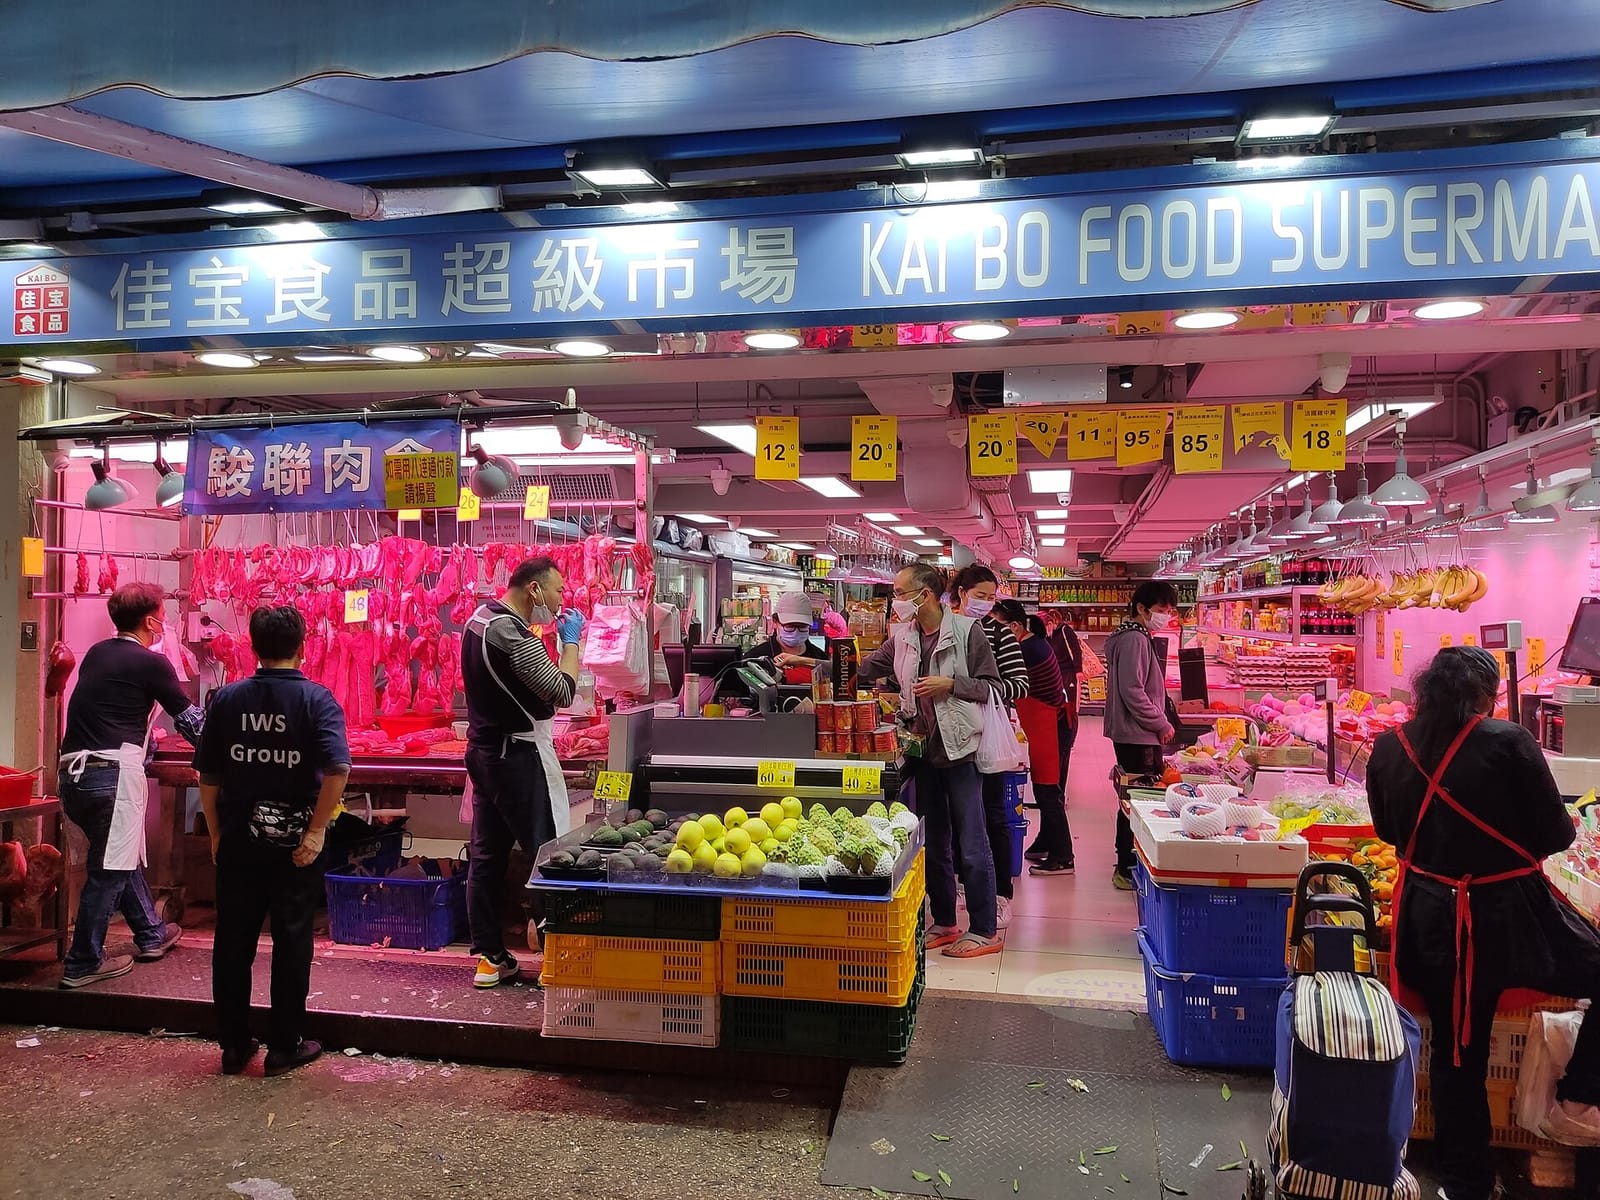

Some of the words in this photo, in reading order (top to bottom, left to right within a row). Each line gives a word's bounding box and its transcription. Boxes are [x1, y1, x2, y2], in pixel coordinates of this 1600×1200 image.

[862, 216, 946, 297] KAI
[974, 208, 1050, 291] BO
[1079, 196, 1243, 286] FOOD
[1271, 173, 1600, 274] SUPERMA
[28, 275, 42, 283] KAI
[110, 224, 799, 331] 佳宝食品超級市場
[20, 289, 64, 309] 佳宝
[19, 313, 63, 333] 食品
[1077, 428, 1100, 442] 11
[1124, 430, 1150, 448] 95
[1181, 434, 1208, 453] 85
[1302, 430, 1330, 449] 18
[763, 443, 786, 461] 12
[858, 443, 883, 461] 20
[978, 440, 1003, 458] 20
[460, 494, 476, 510] 26
[528, 491, 545, 507] 24
[349, 596, 365, 611] 48
[838, 644, 851, 697] Hennessy
[241, 713, 287, 733] IWS
[230, 743, 301, 769] Group
[760, 772, 775, 783] 60
[845, 777, 860, 789] 40
[1055, 976, 1146, 989] CAUTI
[1035, 986, 1097, 998] WET
